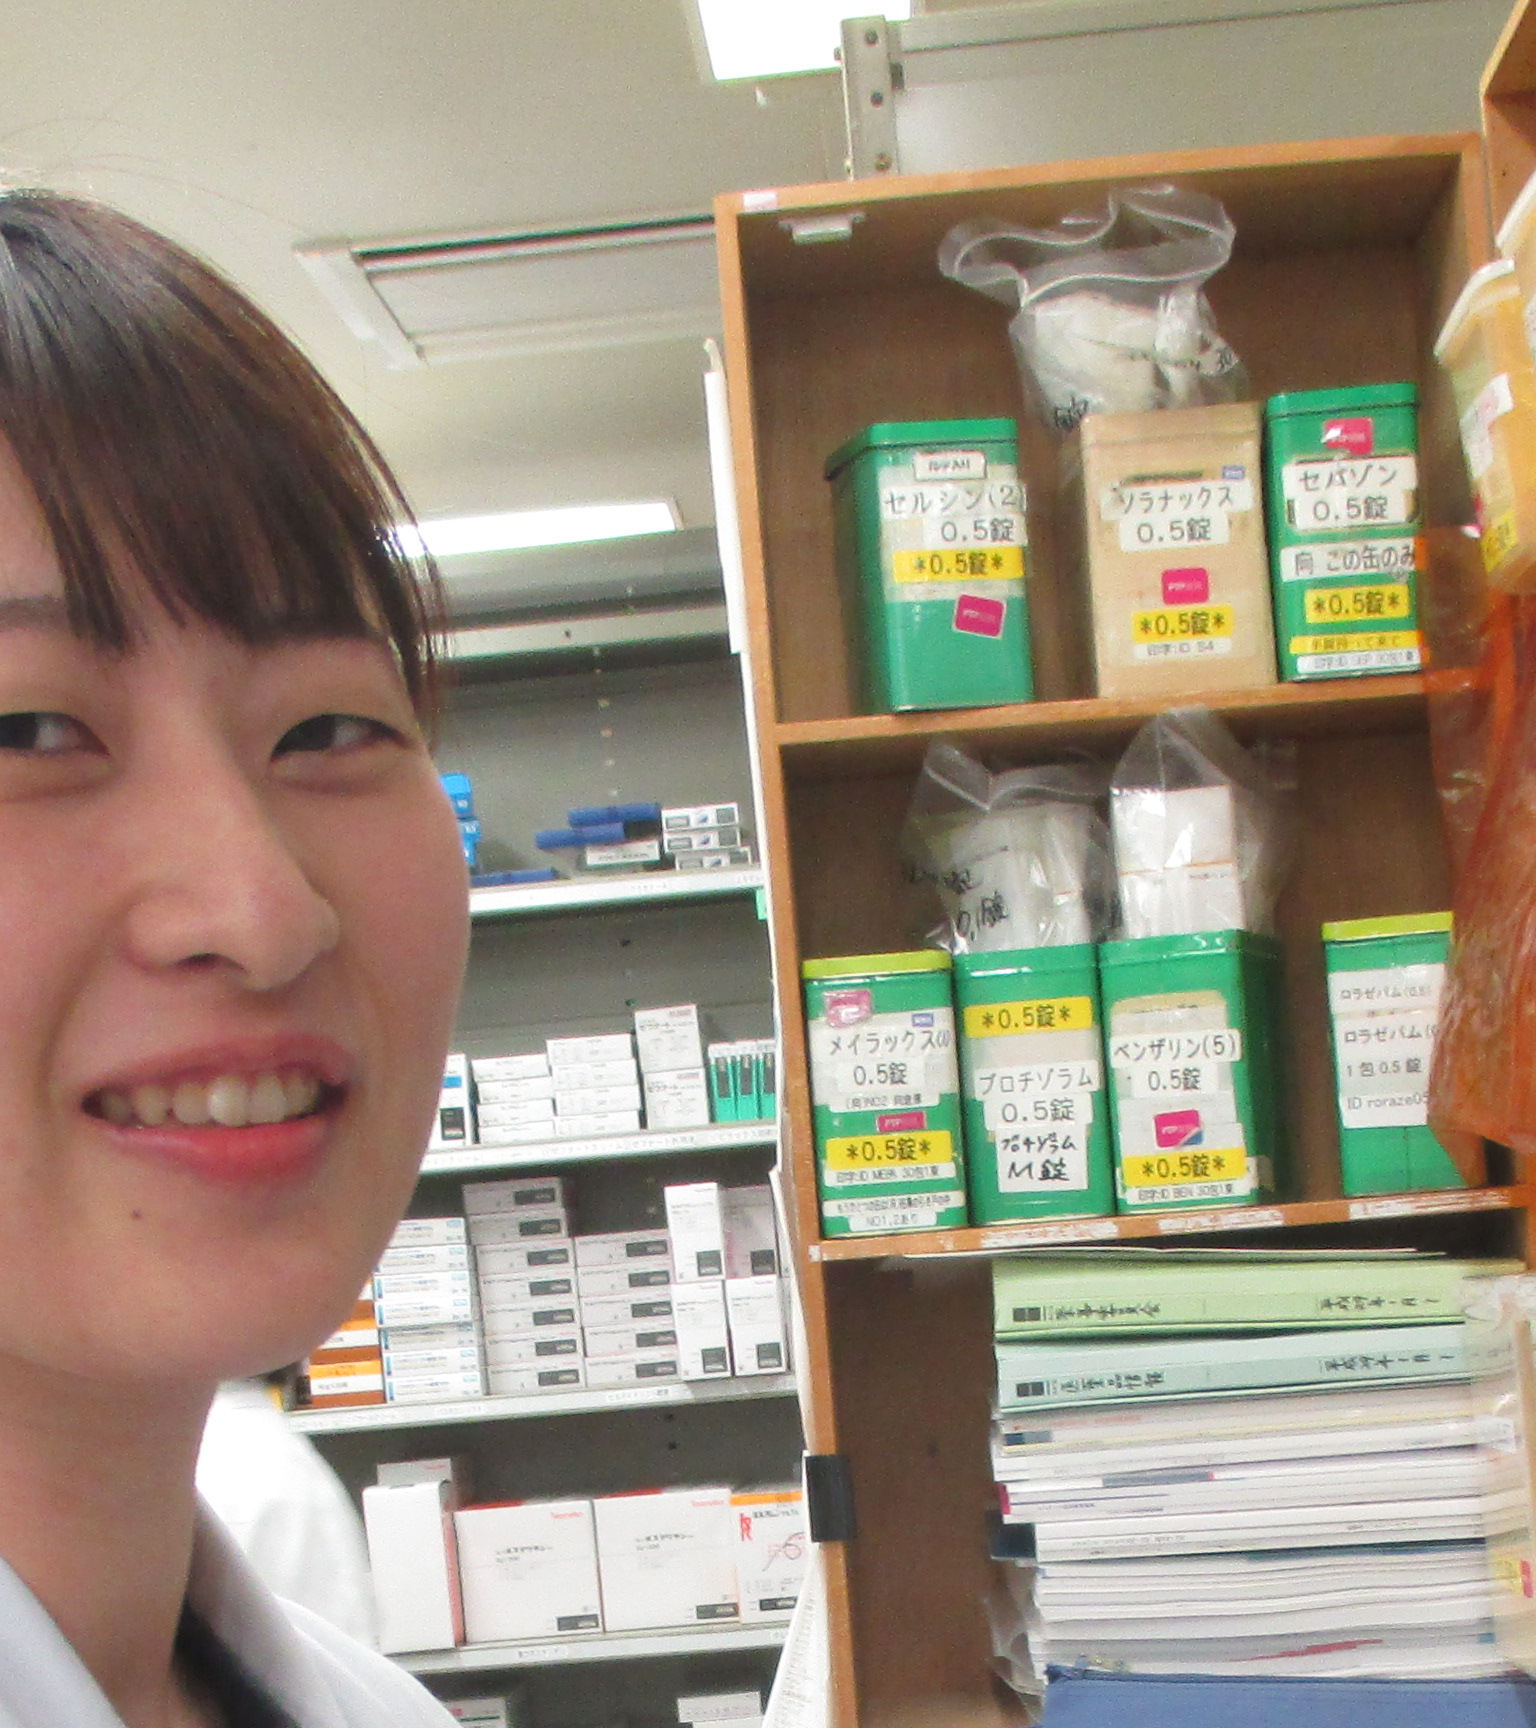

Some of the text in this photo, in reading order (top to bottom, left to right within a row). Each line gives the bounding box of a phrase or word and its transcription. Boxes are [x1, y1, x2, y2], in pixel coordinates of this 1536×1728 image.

[1299, 463, 1399, 492] セパゾン
[884, 483, 1026, 514] セルシン(2)
[1120, 486, 1234, 514] ソラナックス
[1313, 496, 1389, 521] 0.5錠
[941, 518, 1014, 542] 0.5錠
[1137, 517, 1212, 543] 0.5錠
[1114, 1033, 1236, 1062] ベンザリン(5)
[853, 1062, 908, 1086] 0.5錠
[1148, 1067, 1201, 1091] 0.5錠
[1002, 1098, 1075, 1123] 0.5錠
